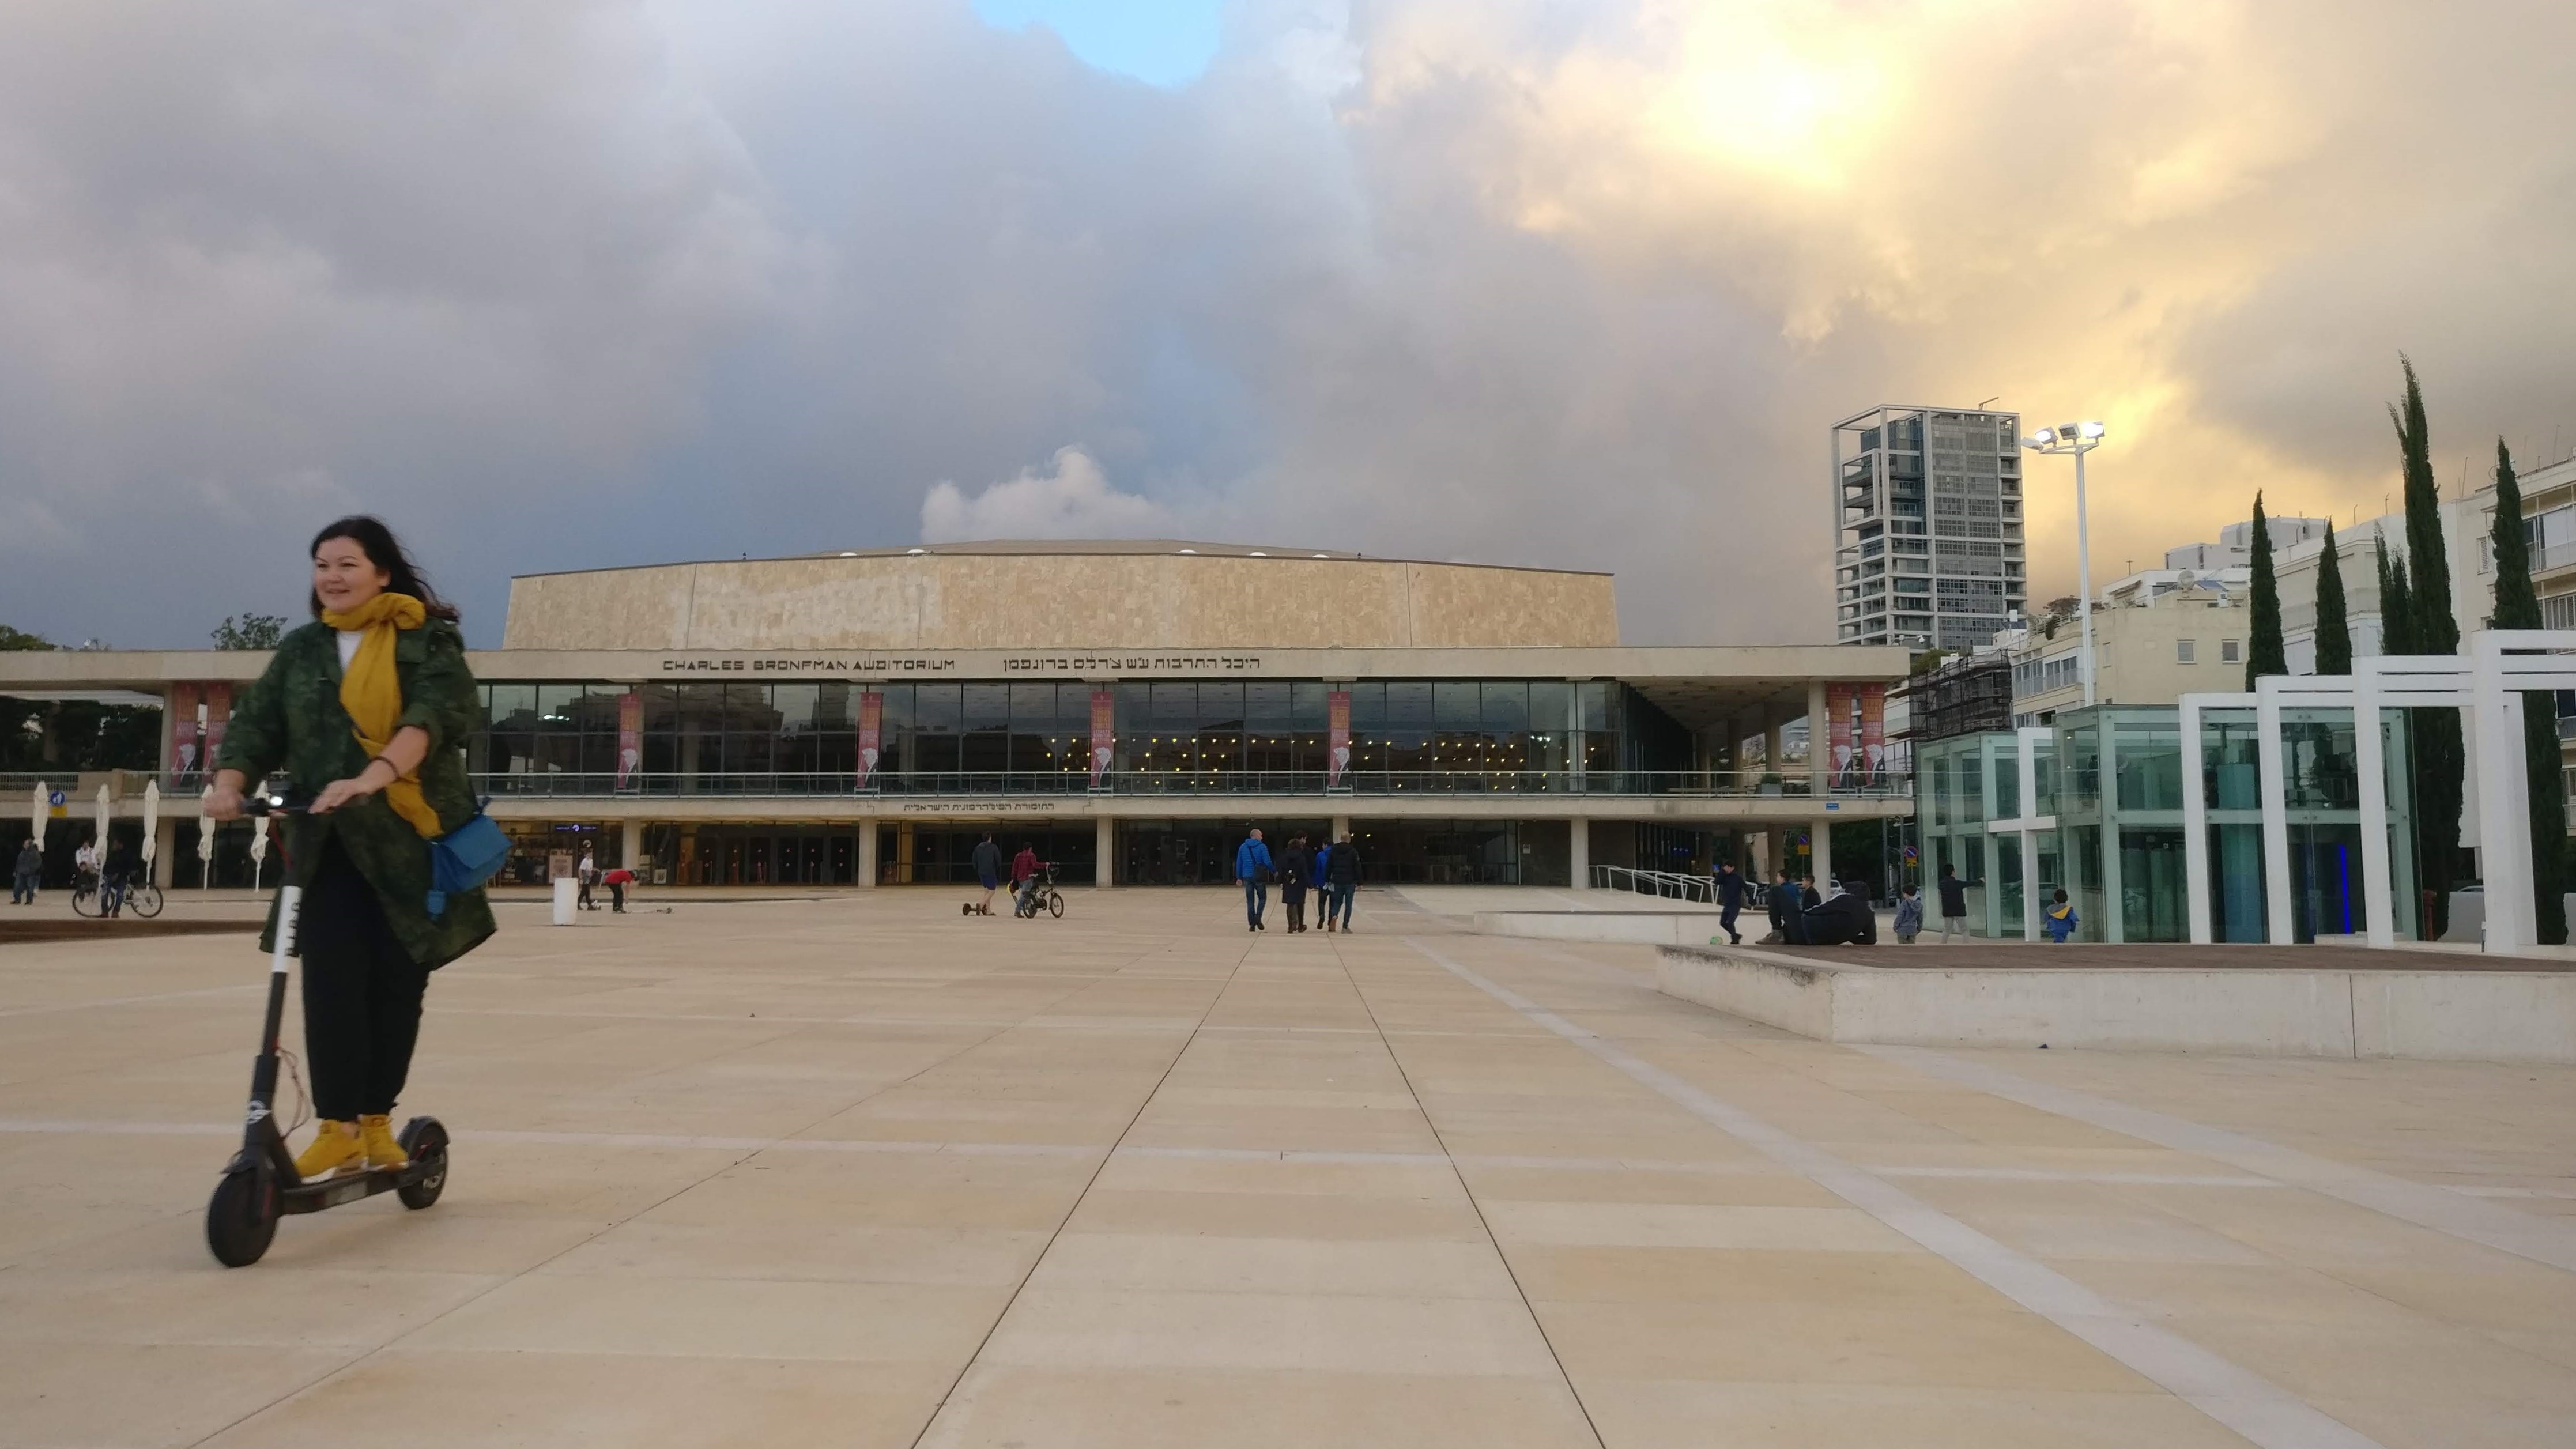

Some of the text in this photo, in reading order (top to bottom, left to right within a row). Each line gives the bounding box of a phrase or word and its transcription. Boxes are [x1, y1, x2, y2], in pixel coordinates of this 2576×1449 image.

[663, 660, 955, 670] CHARLES BRONFMAN AUDITORIUM
[1003, 658, 1069, 672] ברונפמן
[1154, 658, 1217, 669] התרבות
[1221, 656, 1260, 669] היכל
